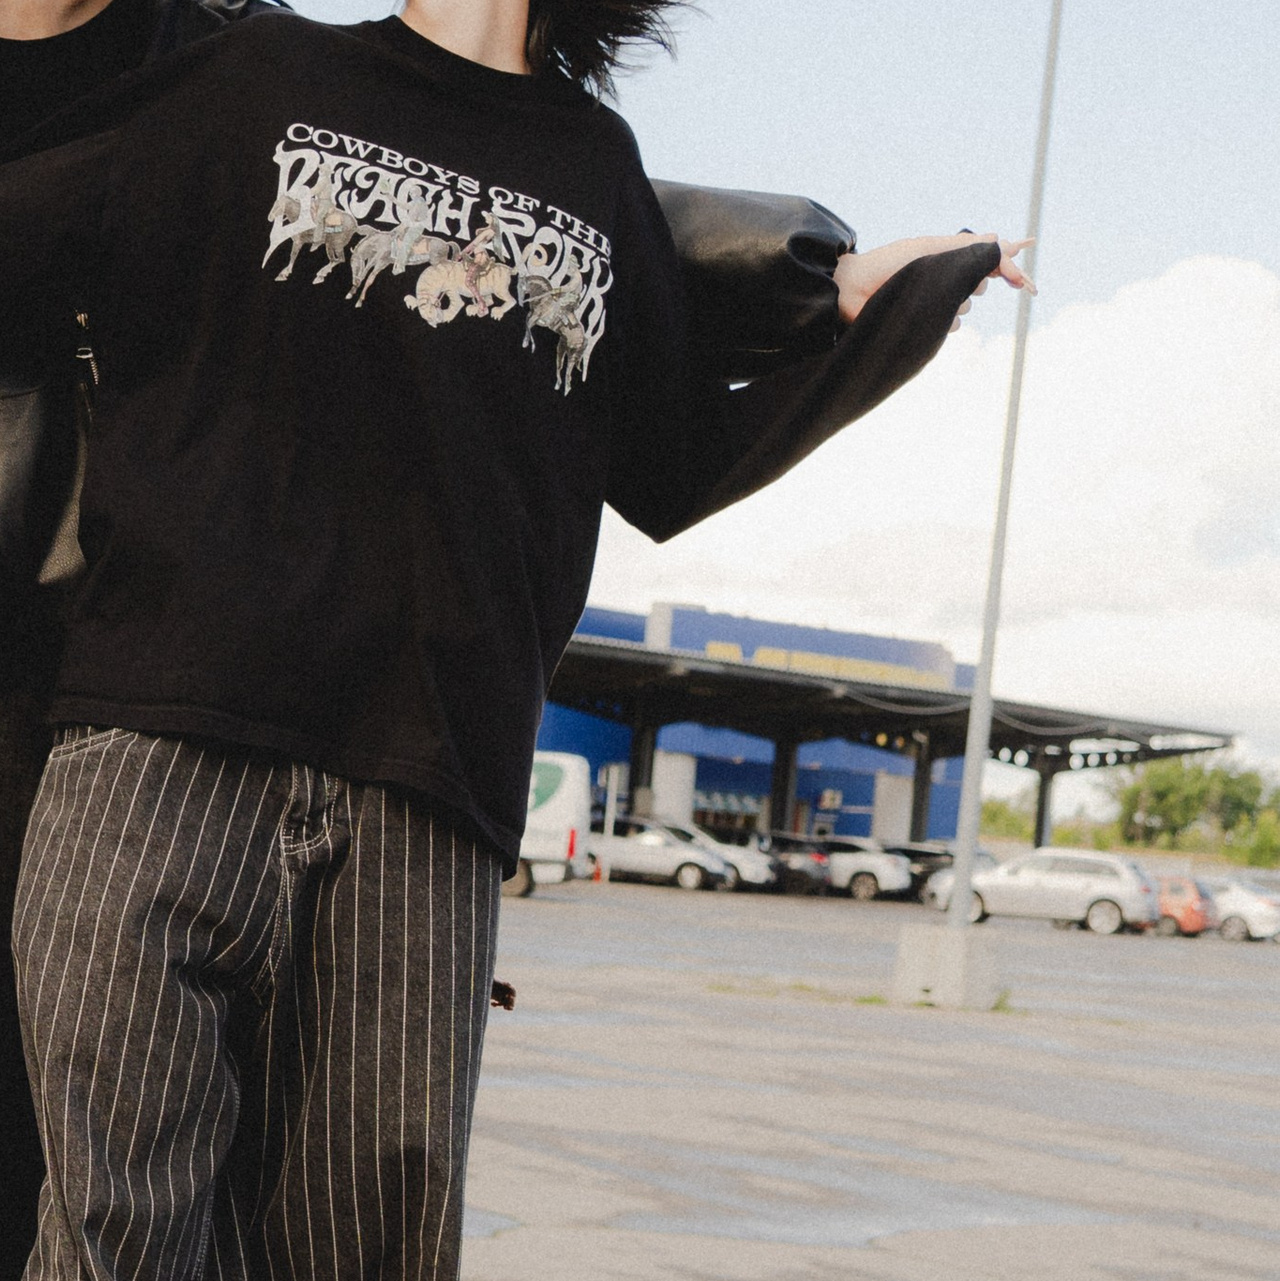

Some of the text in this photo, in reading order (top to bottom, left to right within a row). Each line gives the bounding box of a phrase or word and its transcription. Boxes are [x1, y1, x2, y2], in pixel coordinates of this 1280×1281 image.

[286, 122, 612, 257] COWBOYS OF THE
